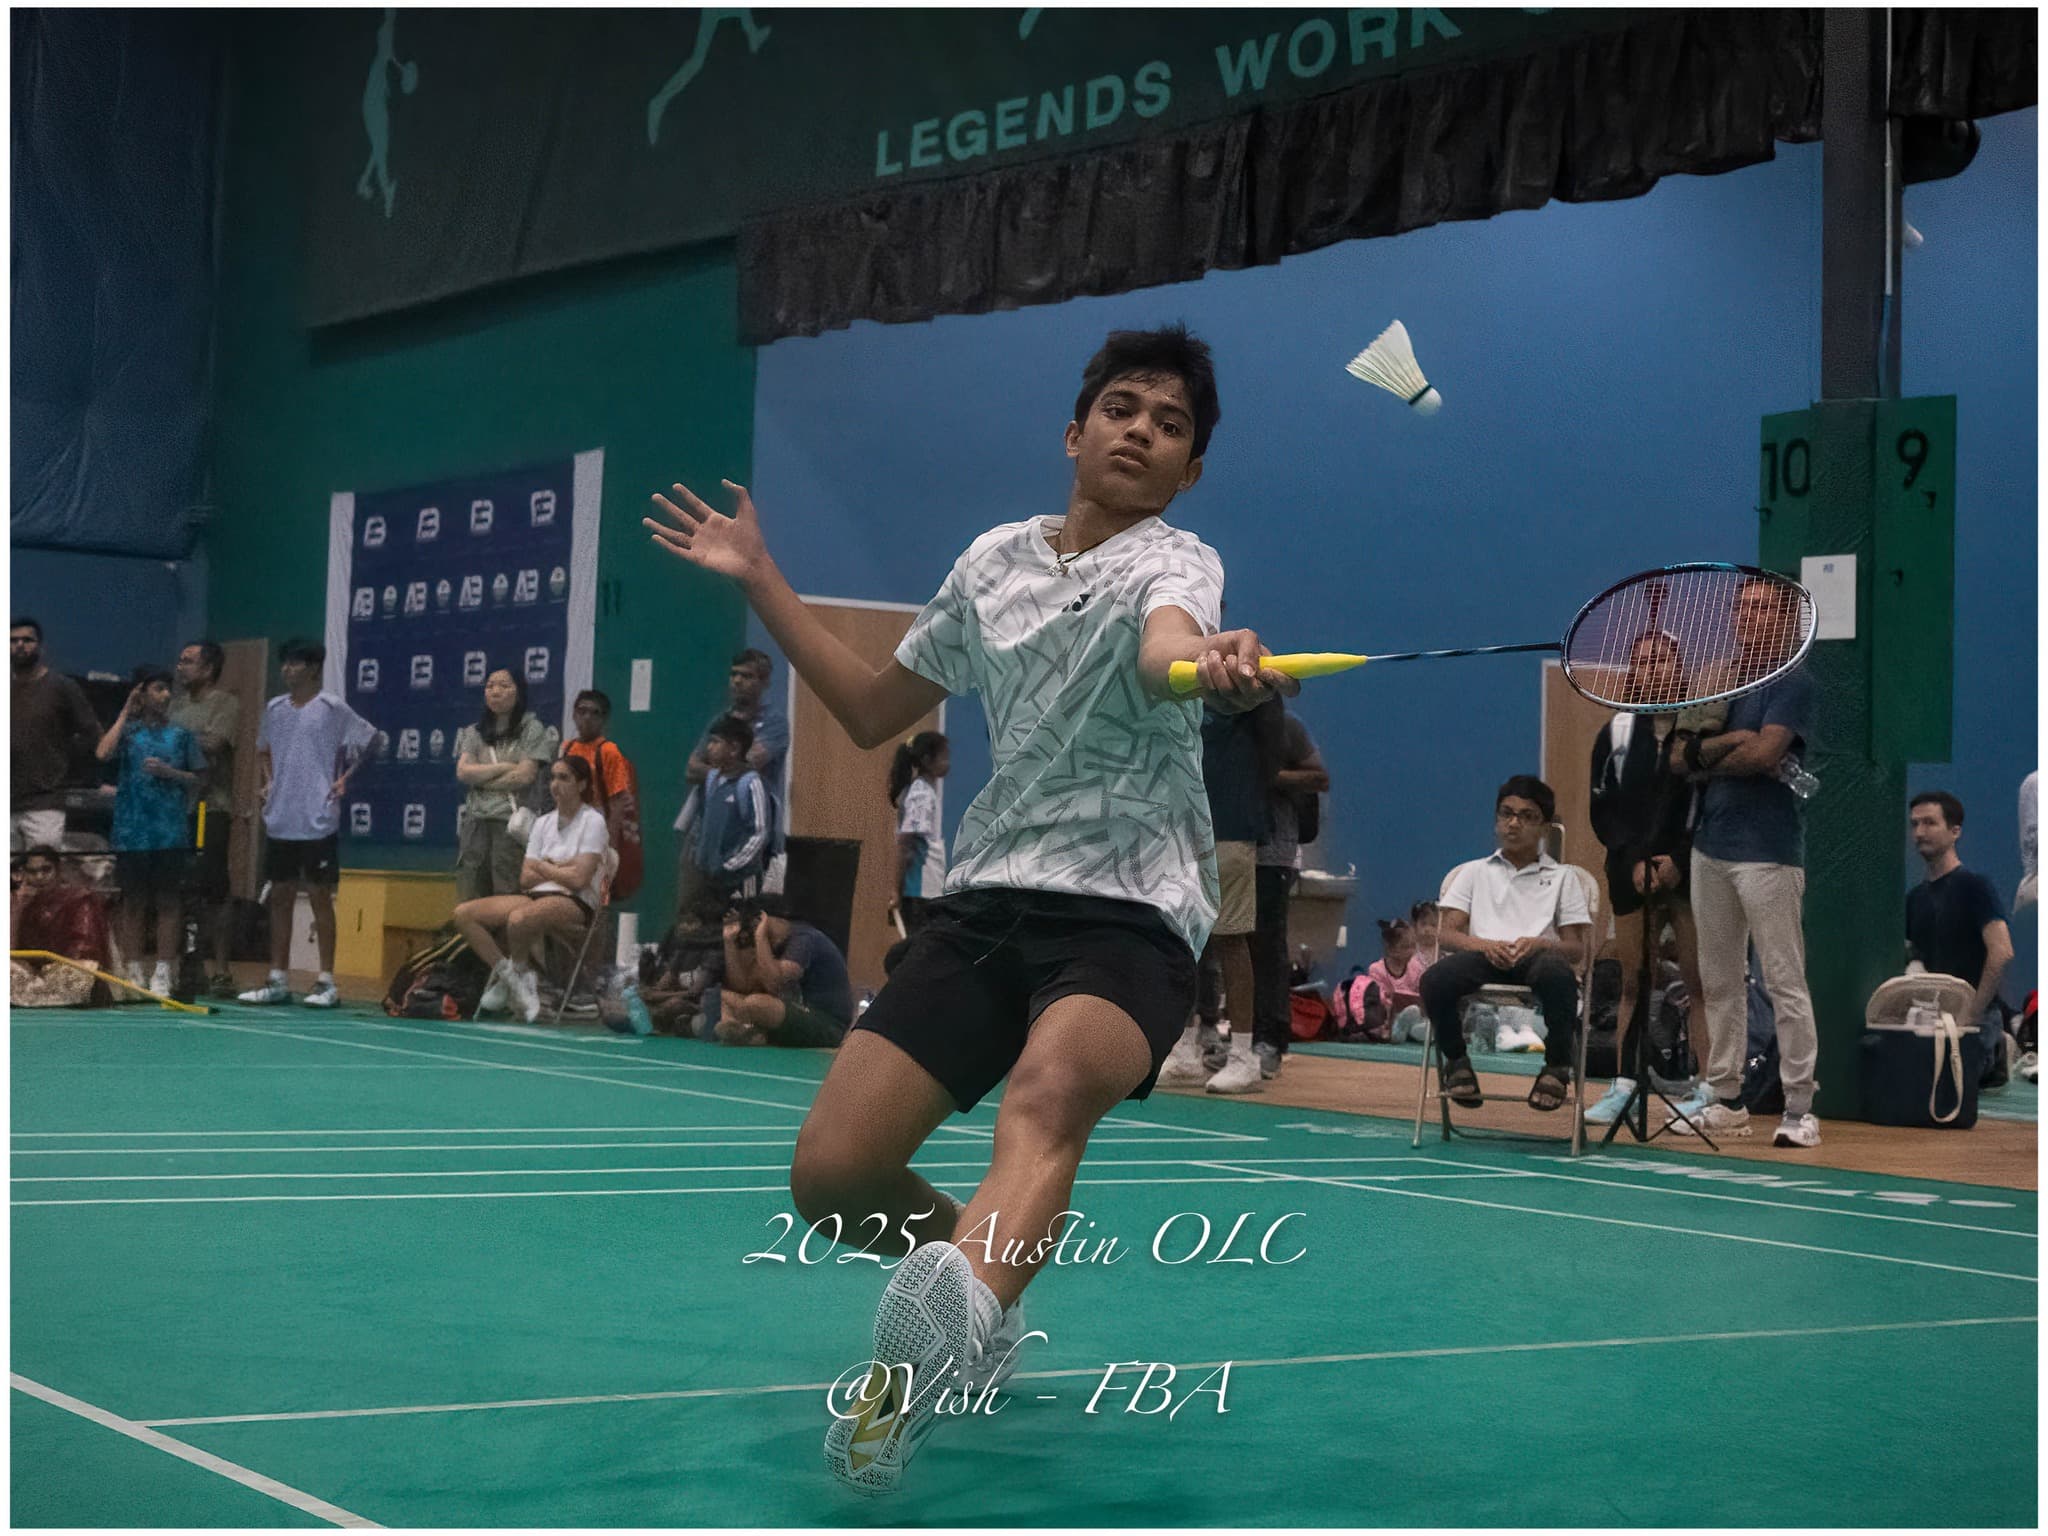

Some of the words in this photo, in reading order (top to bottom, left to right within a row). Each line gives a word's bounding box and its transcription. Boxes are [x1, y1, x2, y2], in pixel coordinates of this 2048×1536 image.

[875, 61, 1172, 177] LEGENDS
[1216, 8, 1463, 97] WORK
[1762, 438, 1811, 501] 10
[1899, 428, 1928, 488] 9
